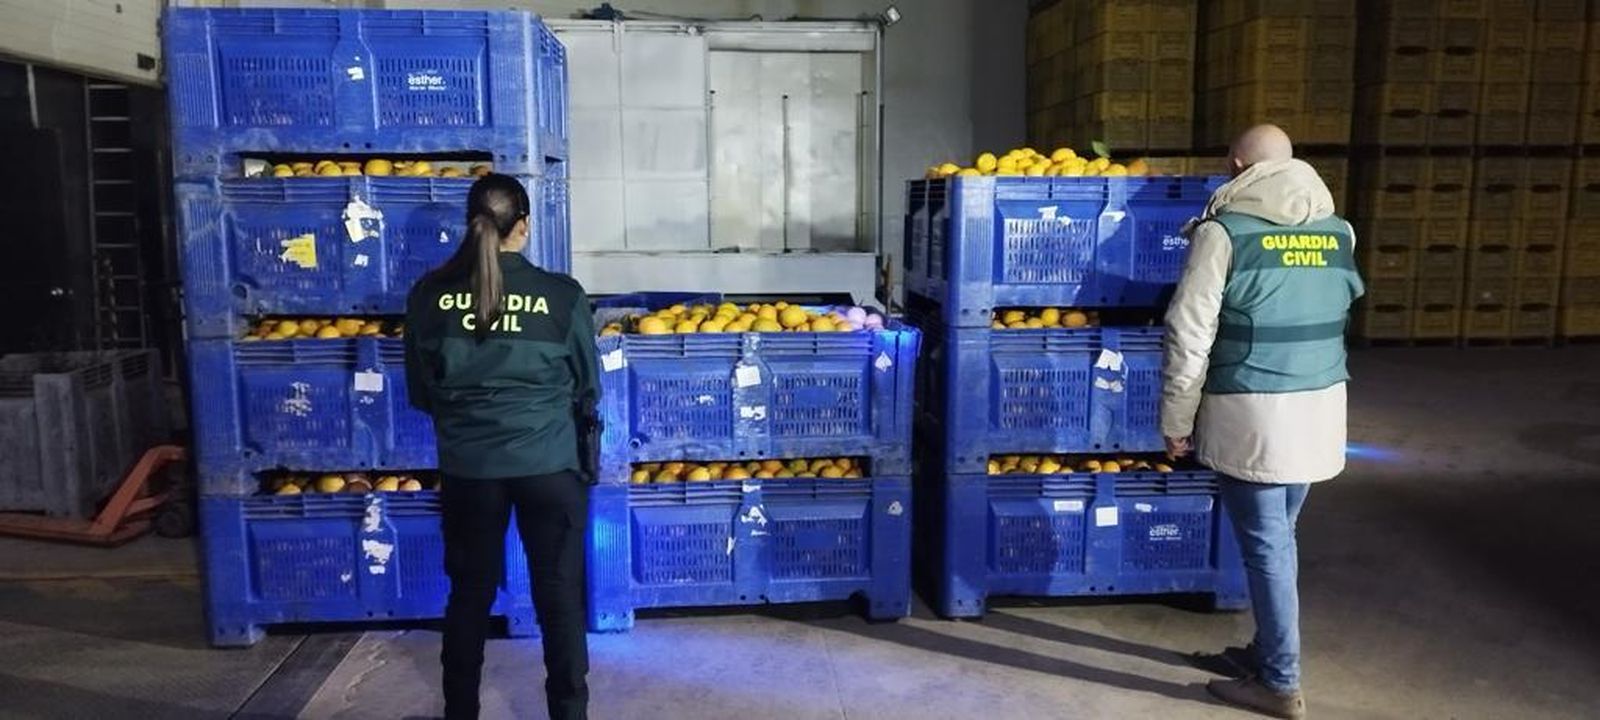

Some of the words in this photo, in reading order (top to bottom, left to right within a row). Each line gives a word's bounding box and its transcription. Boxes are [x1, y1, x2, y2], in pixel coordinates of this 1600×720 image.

[1262, 234, 1339, 250] GUARDIA
[1282, 251, 1328, 266] CIVIL
[438, 293, 549, 314] GUDIA
